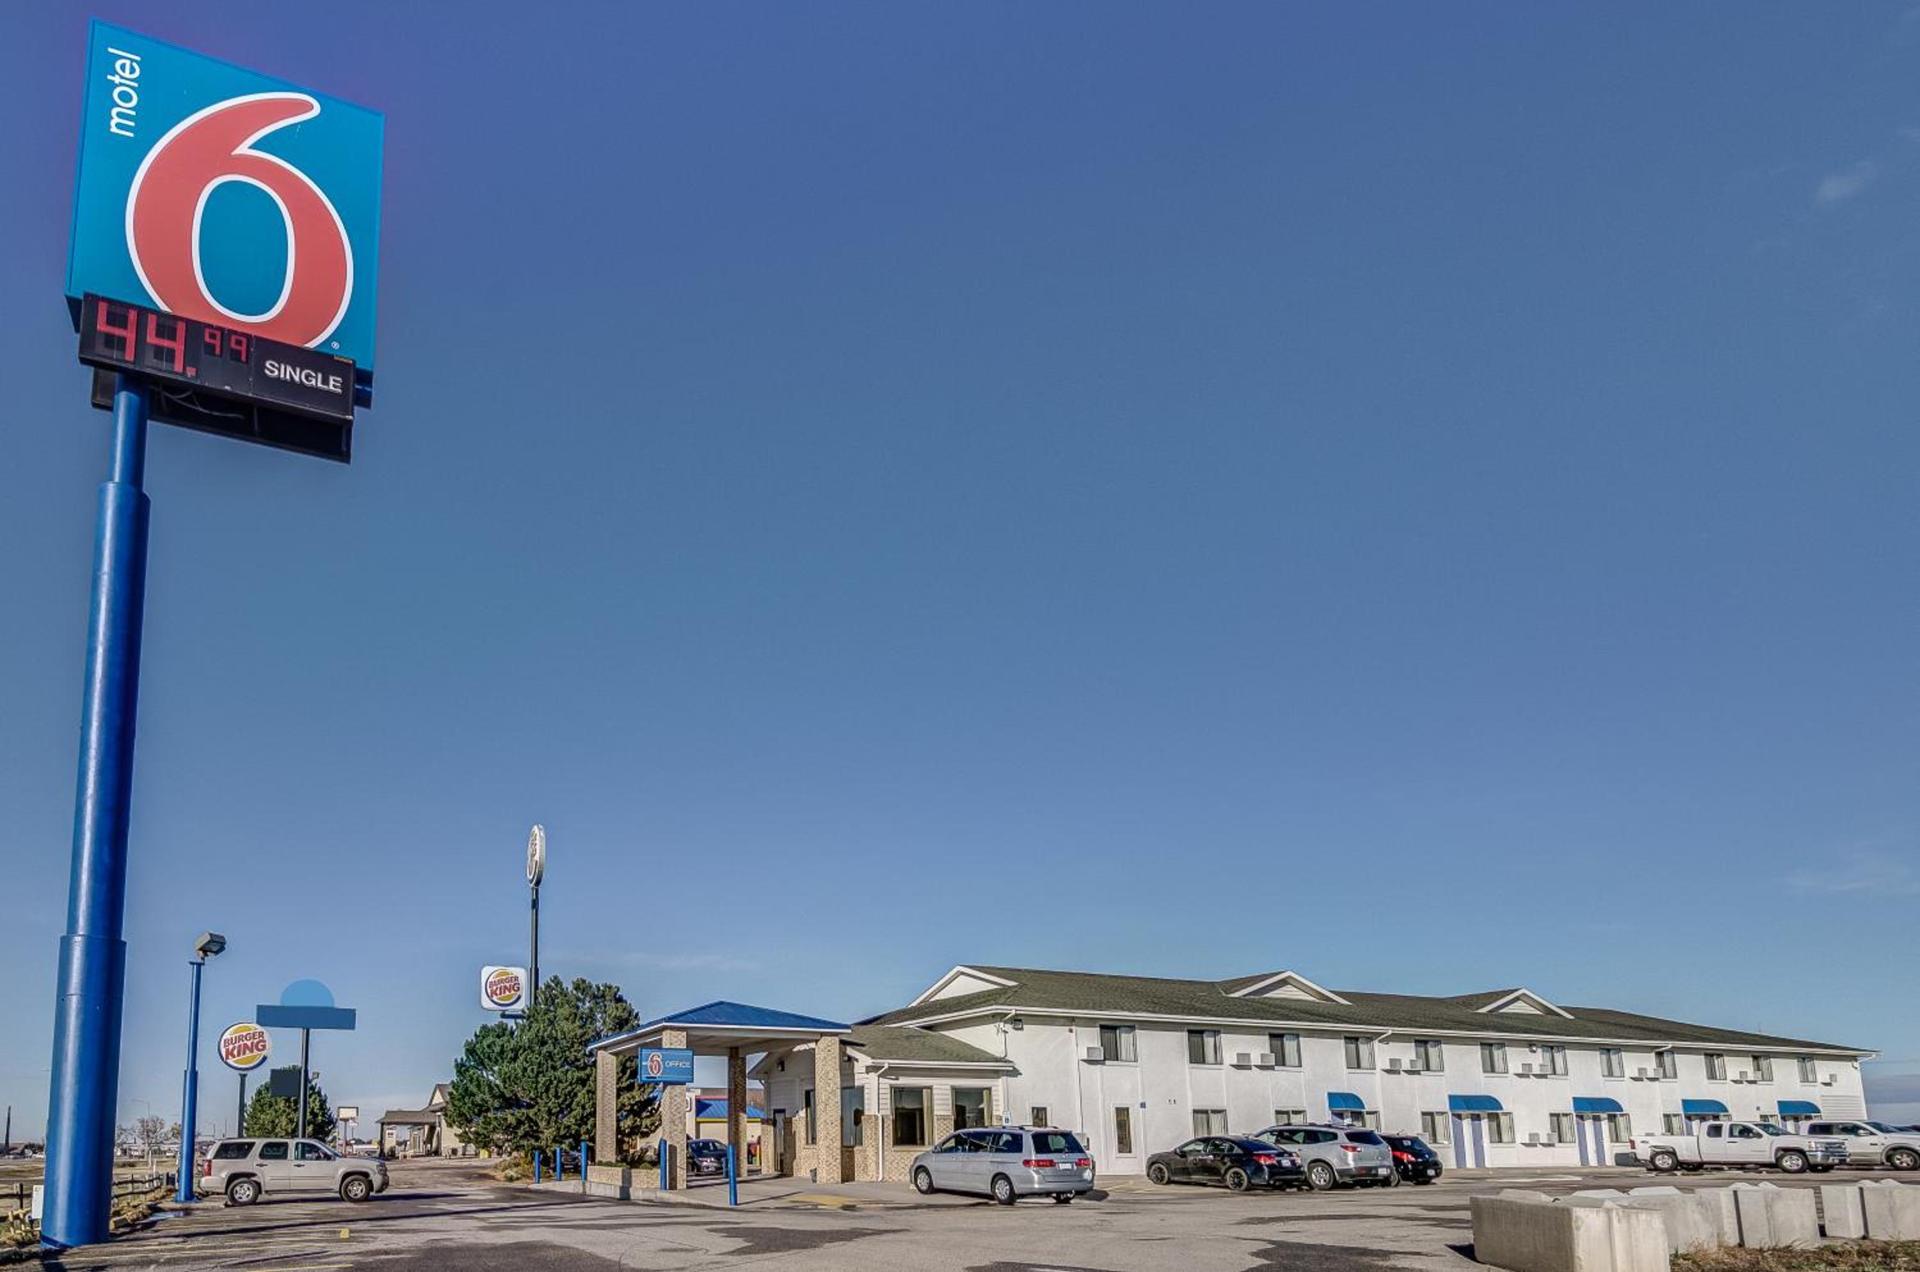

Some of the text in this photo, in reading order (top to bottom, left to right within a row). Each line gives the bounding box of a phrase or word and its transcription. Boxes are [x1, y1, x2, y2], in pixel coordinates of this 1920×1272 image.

[107, 47, 354, 349] motel 6
[264, 359, 344, 394] SINGLE
[489, 975, 519, 988] BURGER
[490, 982, 520, 998] KING
[223, 1031, 264, 1048] BURGER
[224, 1039, 267, 1060] KING
